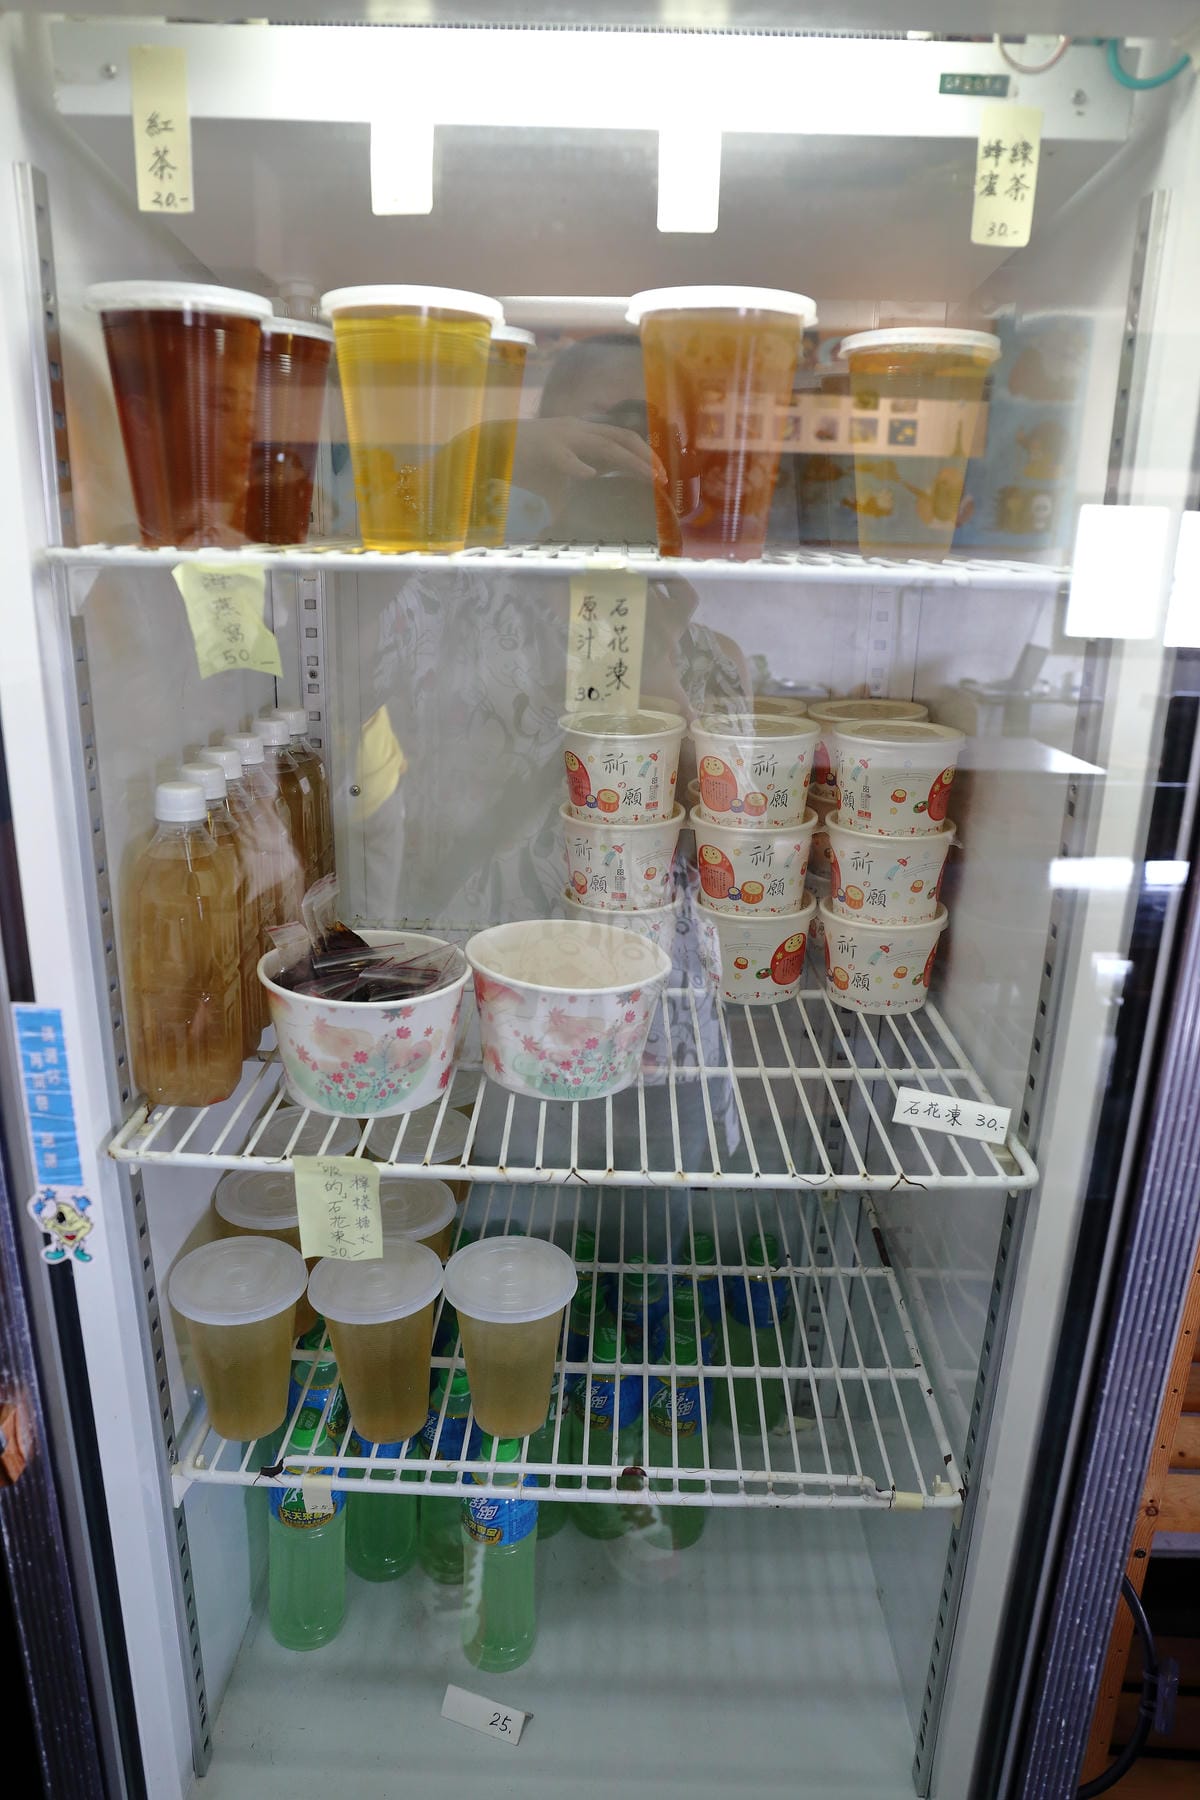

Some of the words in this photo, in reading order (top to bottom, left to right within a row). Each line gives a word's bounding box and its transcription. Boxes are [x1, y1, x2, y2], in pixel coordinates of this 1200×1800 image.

[145, 111, 177, 180] 紅茶
[577, 595, 597, 660] 原汁
[903, 1101, 963, 1127] 石花凍
